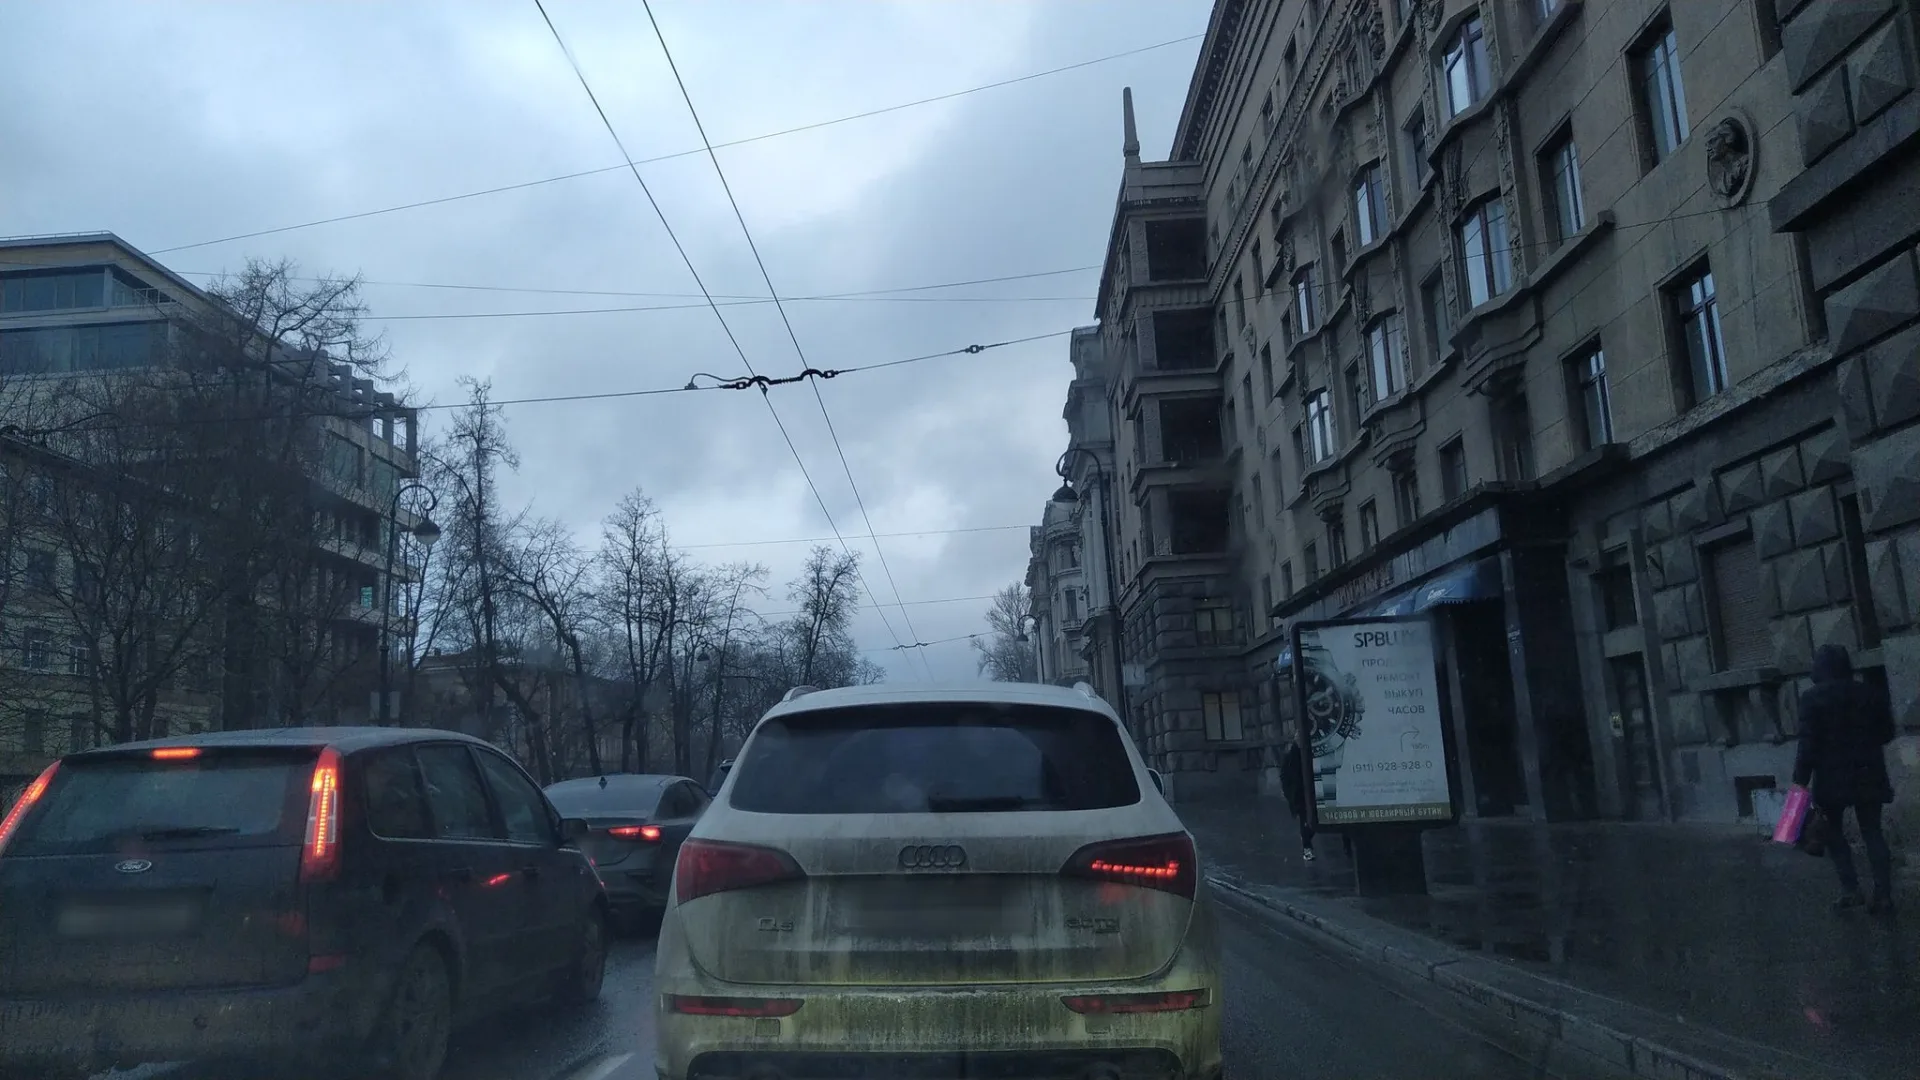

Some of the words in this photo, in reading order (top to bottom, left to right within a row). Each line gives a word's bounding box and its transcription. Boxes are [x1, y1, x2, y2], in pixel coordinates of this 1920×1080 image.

[1387, 704, 1426, 715] ЧАСОВ
[1352, 763, 1374, 774] (911)
[1377, 760, 1433, 772] 928-928-0
[1325, 809, 1358, 820] ЧАСОВОЙ
[1360, 809, 1366, 818] И
[1368, 806, 1415, 818] ЮВЕЛИРНЫЙ
[1417, 806, 1442, 817] БУТИК
